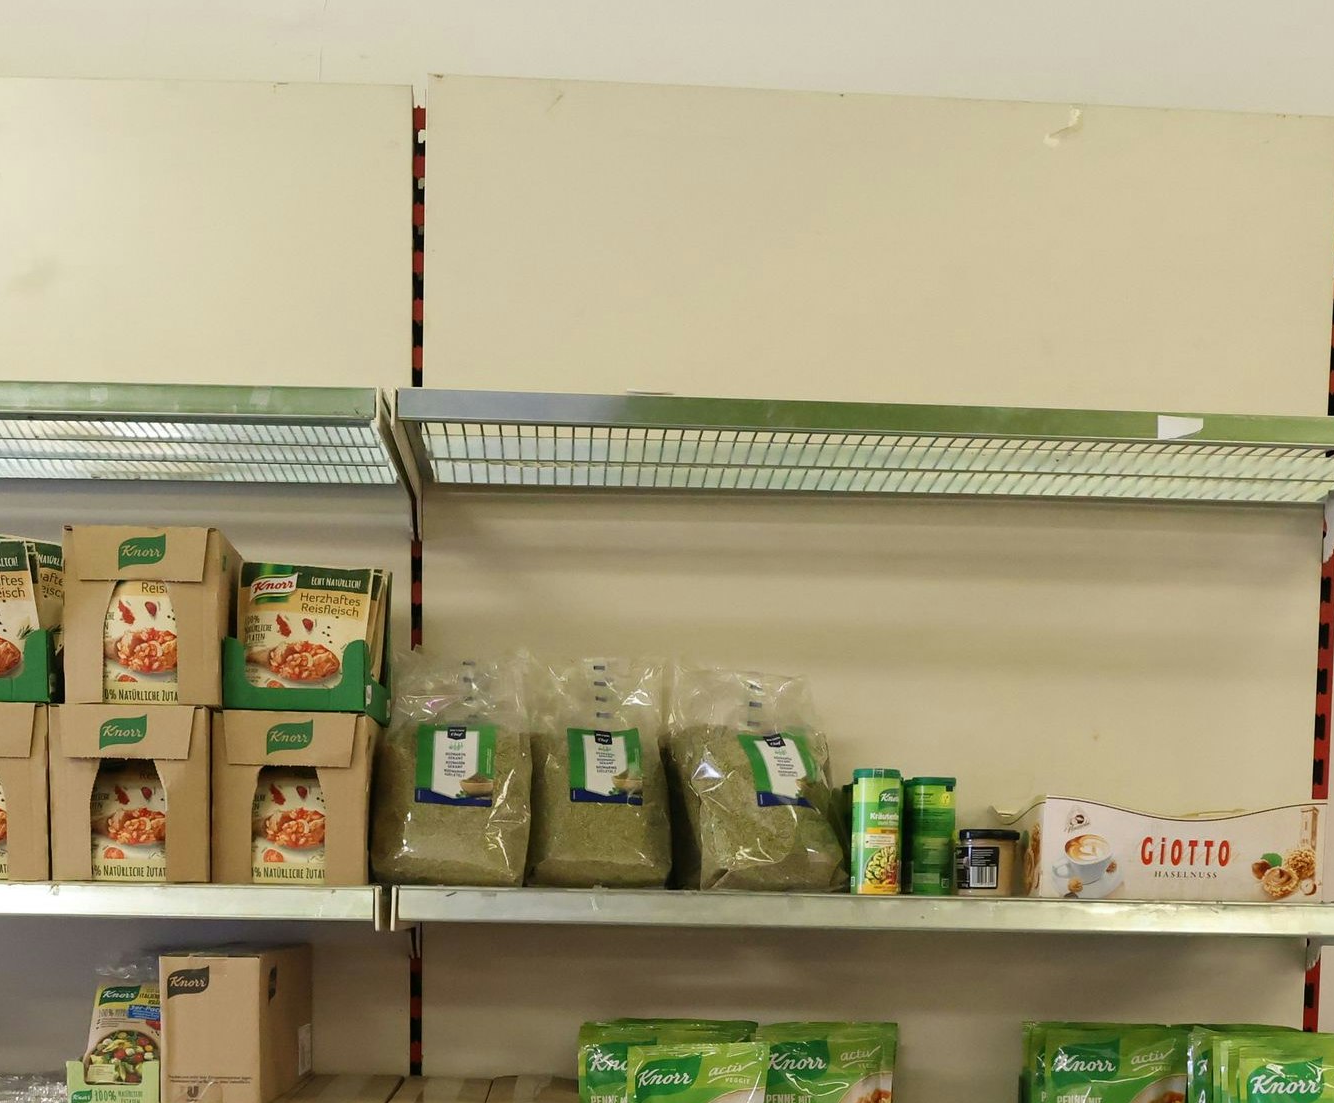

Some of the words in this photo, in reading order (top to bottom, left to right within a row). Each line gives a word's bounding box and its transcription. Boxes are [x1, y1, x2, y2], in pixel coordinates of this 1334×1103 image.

[121, 544, 163, 558] Knorr
[253, 580, 295, 593] Knorr
[326, 577, 361, 589] NATÜRLICH!
[300, 593, 361, 607] Herzhaftes
[301, 604, 359, 617] Reisfleisch
[103, 724, 143, 738] Knorr
[1154, 870, 1218, 879] HASELNUSS
[170, 976, 206, 988] Knorr
[769, 1054, 826, 1070] Knorr
[1055, 1053, 1116, 1073] Knorr
[638, 1069, 692, 1088] Knorr
[1251, 1074, 1319, 1095] Knorr
